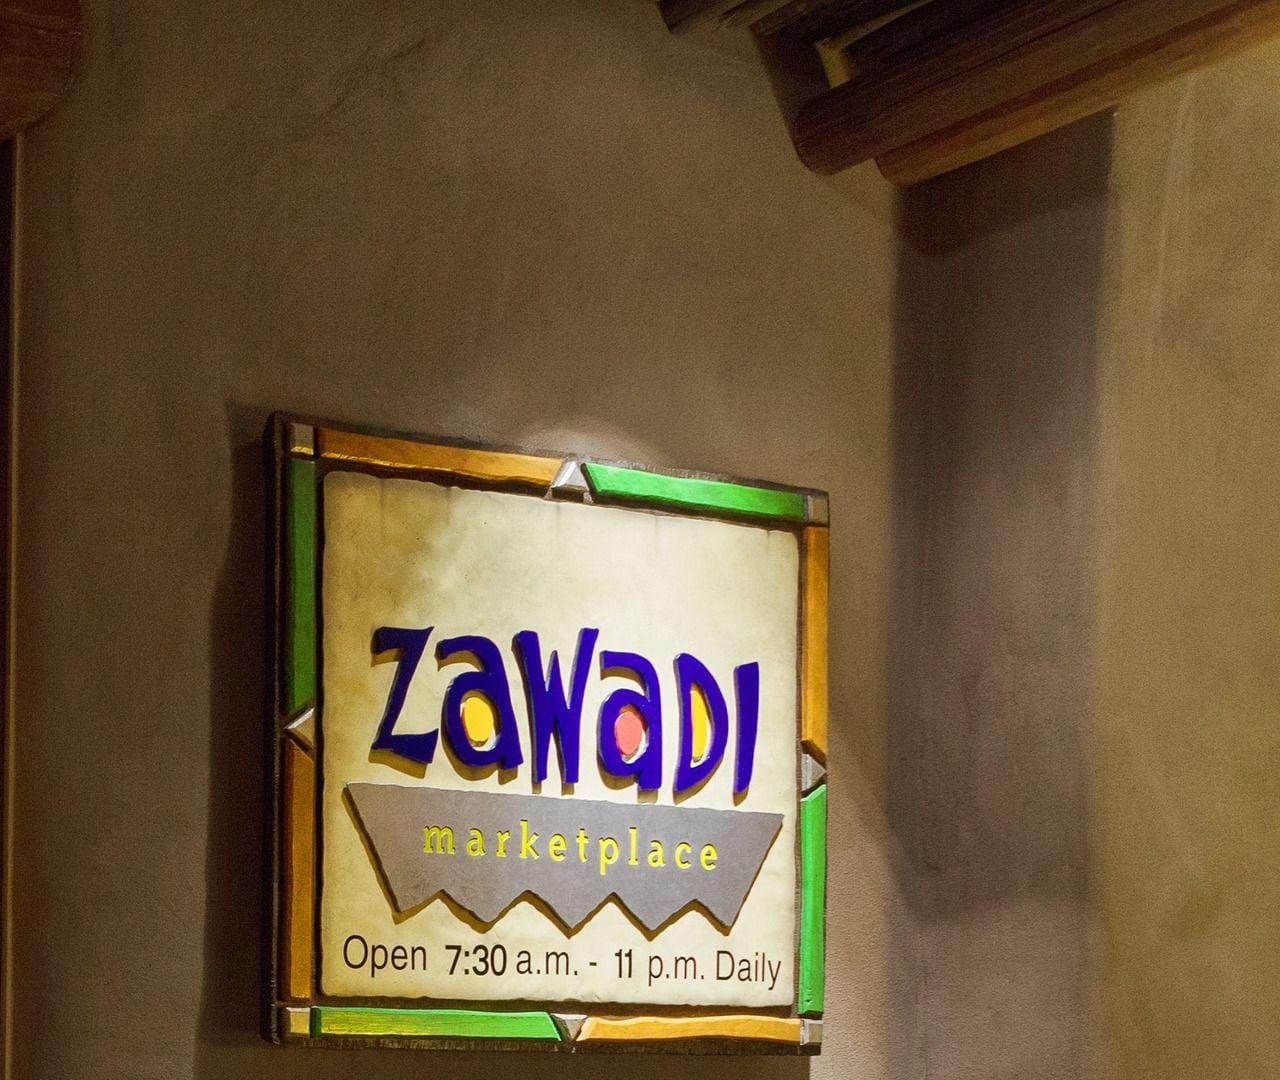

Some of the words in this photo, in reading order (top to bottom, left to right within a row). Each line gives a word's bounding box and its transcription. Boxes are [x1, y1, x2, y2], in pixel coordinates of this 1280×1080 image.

[422, 818, 719, 876] marketplace
[342, 934, 428, 979] Open
[444, 943, 508, 977] 7:30
[515, 948, 579, 977] a.m.
[613, 948, 633, 979] 11
[647, 953, 706, 988] p.m.
[714, 949, 782, 992] Daily
